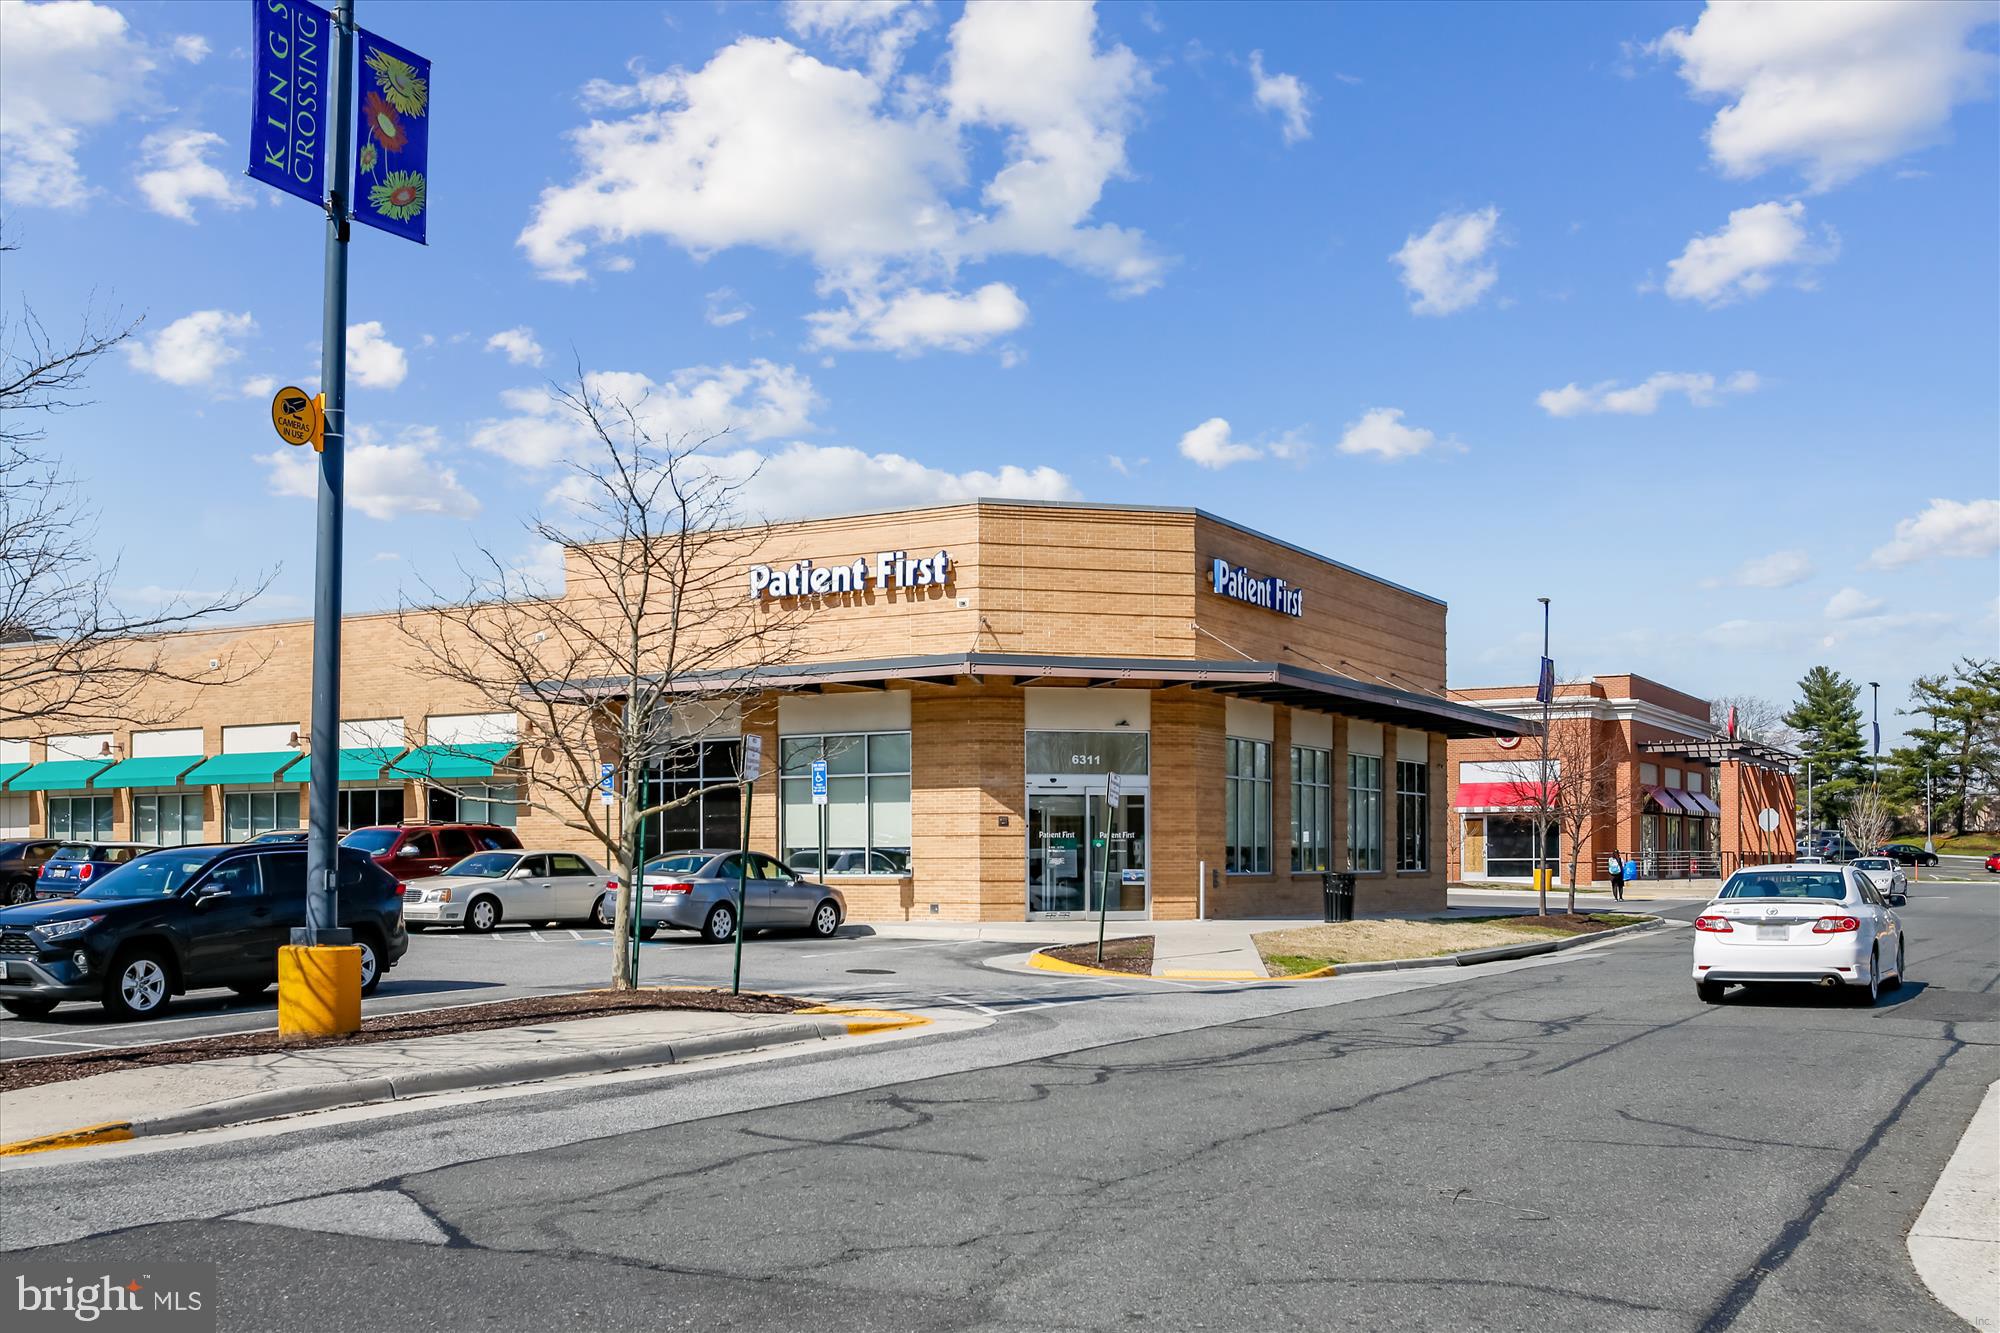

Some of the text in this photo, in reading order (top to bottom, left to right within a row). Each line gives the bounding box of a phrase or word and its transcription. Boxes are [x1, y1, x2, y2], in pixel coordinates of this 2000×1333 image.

[264, 0, 289, 170] KINGS
[294, 13, 318, 183] CROSSING
[278, 416, 310, 432] CAMERAS
[283, 427, 305, 440] IN USE
[750, 549, 948, 600] Patient First
[1213, 558, 1303, 617] Patient First
[1071, 754, 1101, 765] 6311
[1062, 830, 1075, 839] First
[1099, 831, 1136, 839] Paent First
